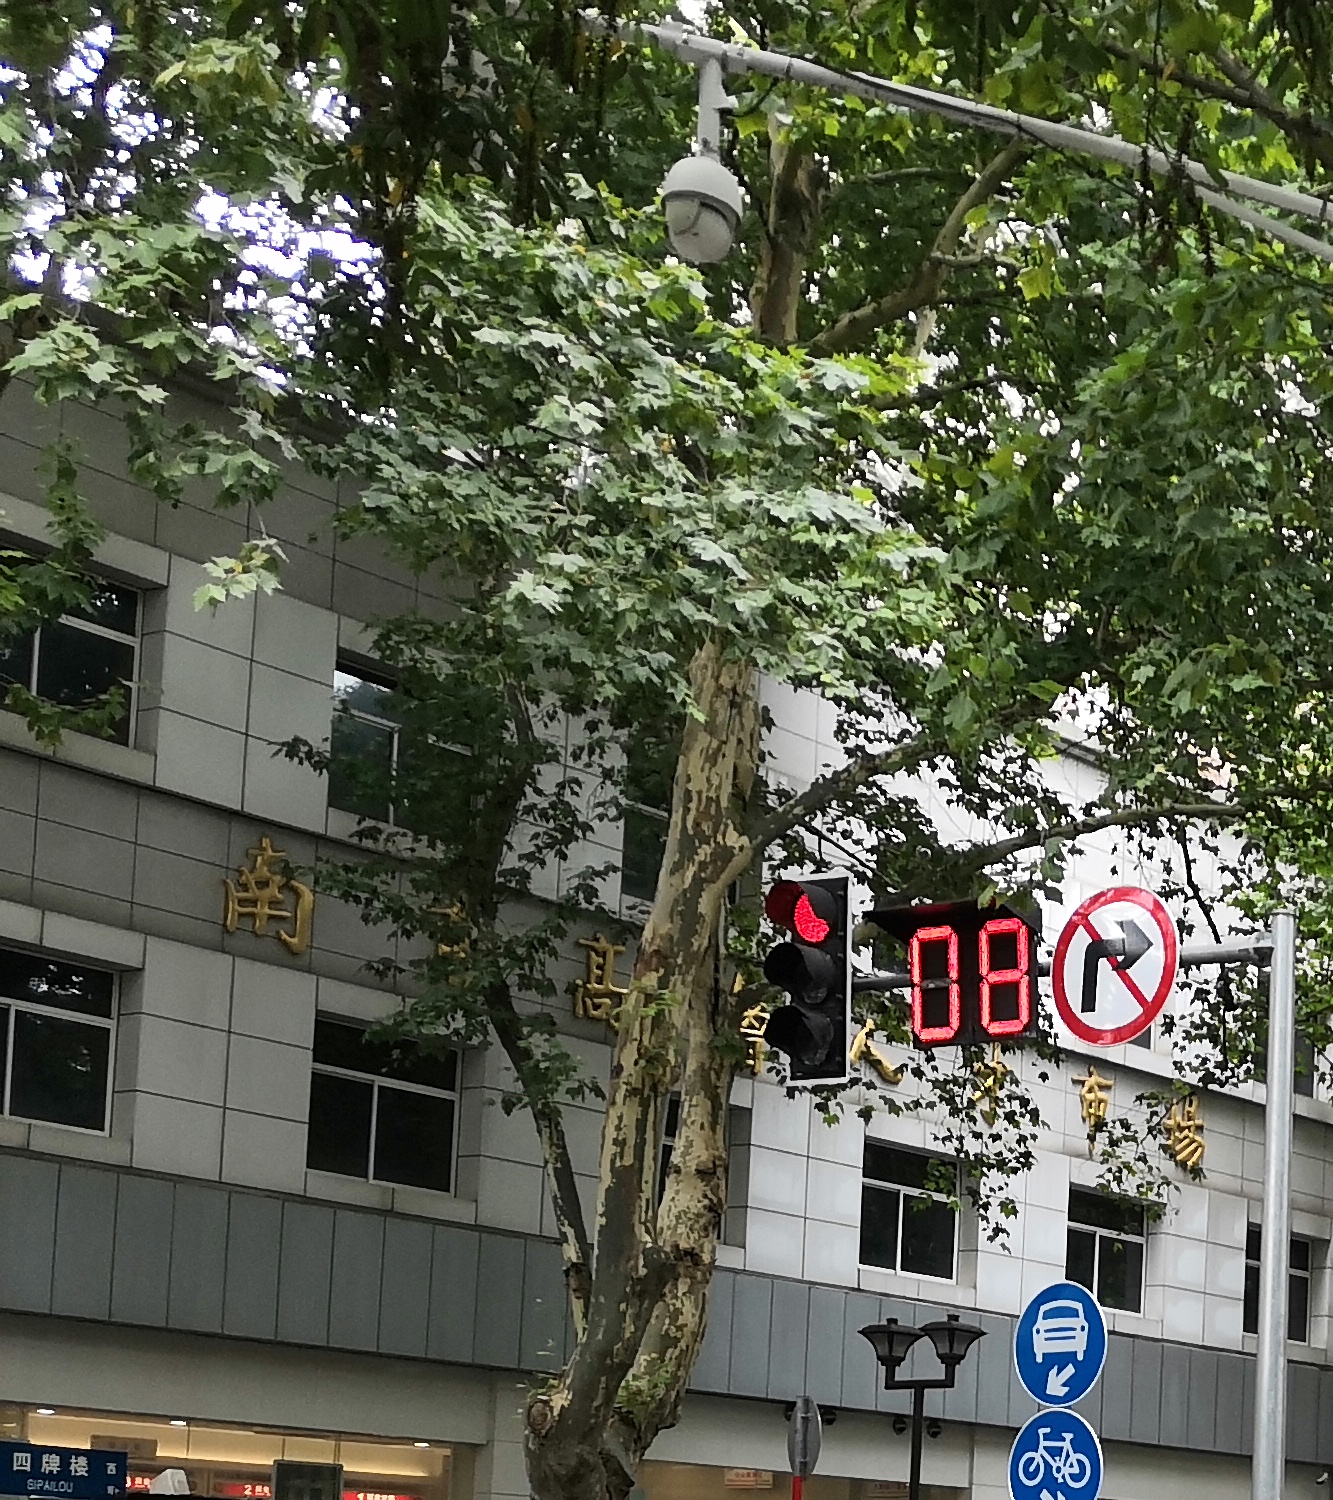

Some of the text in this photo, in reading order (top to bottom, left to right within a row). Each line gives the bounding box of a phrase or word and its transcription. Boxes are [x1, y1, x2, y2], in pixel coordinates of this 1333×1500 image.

[909, 917, 1030, 1042] 08
[12, 1451, 89, 1477] 四牌楼
[26, 1478, 74, 1493] SIPAILOU
